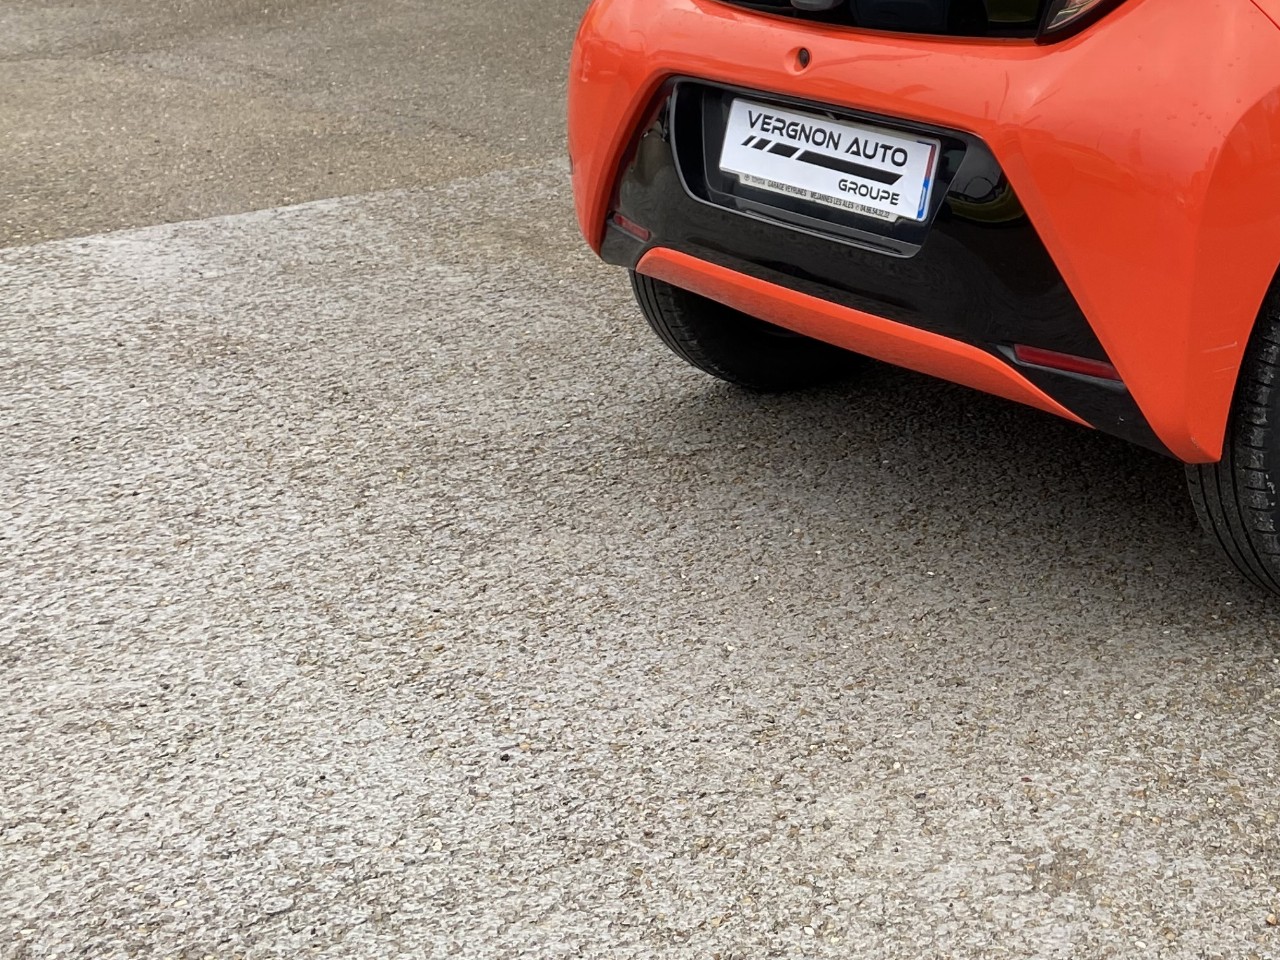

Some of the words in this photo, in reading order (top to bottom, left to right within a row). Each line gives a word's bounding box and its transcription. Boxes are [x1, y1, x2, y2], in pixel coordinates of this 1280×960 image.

[748, 110, 842, 150] VERGNON
[844, 136, 908, 168] AUTO
[767, 179, 785, 192] GARAGE
[838, 178, 900, 206] GROUPE
